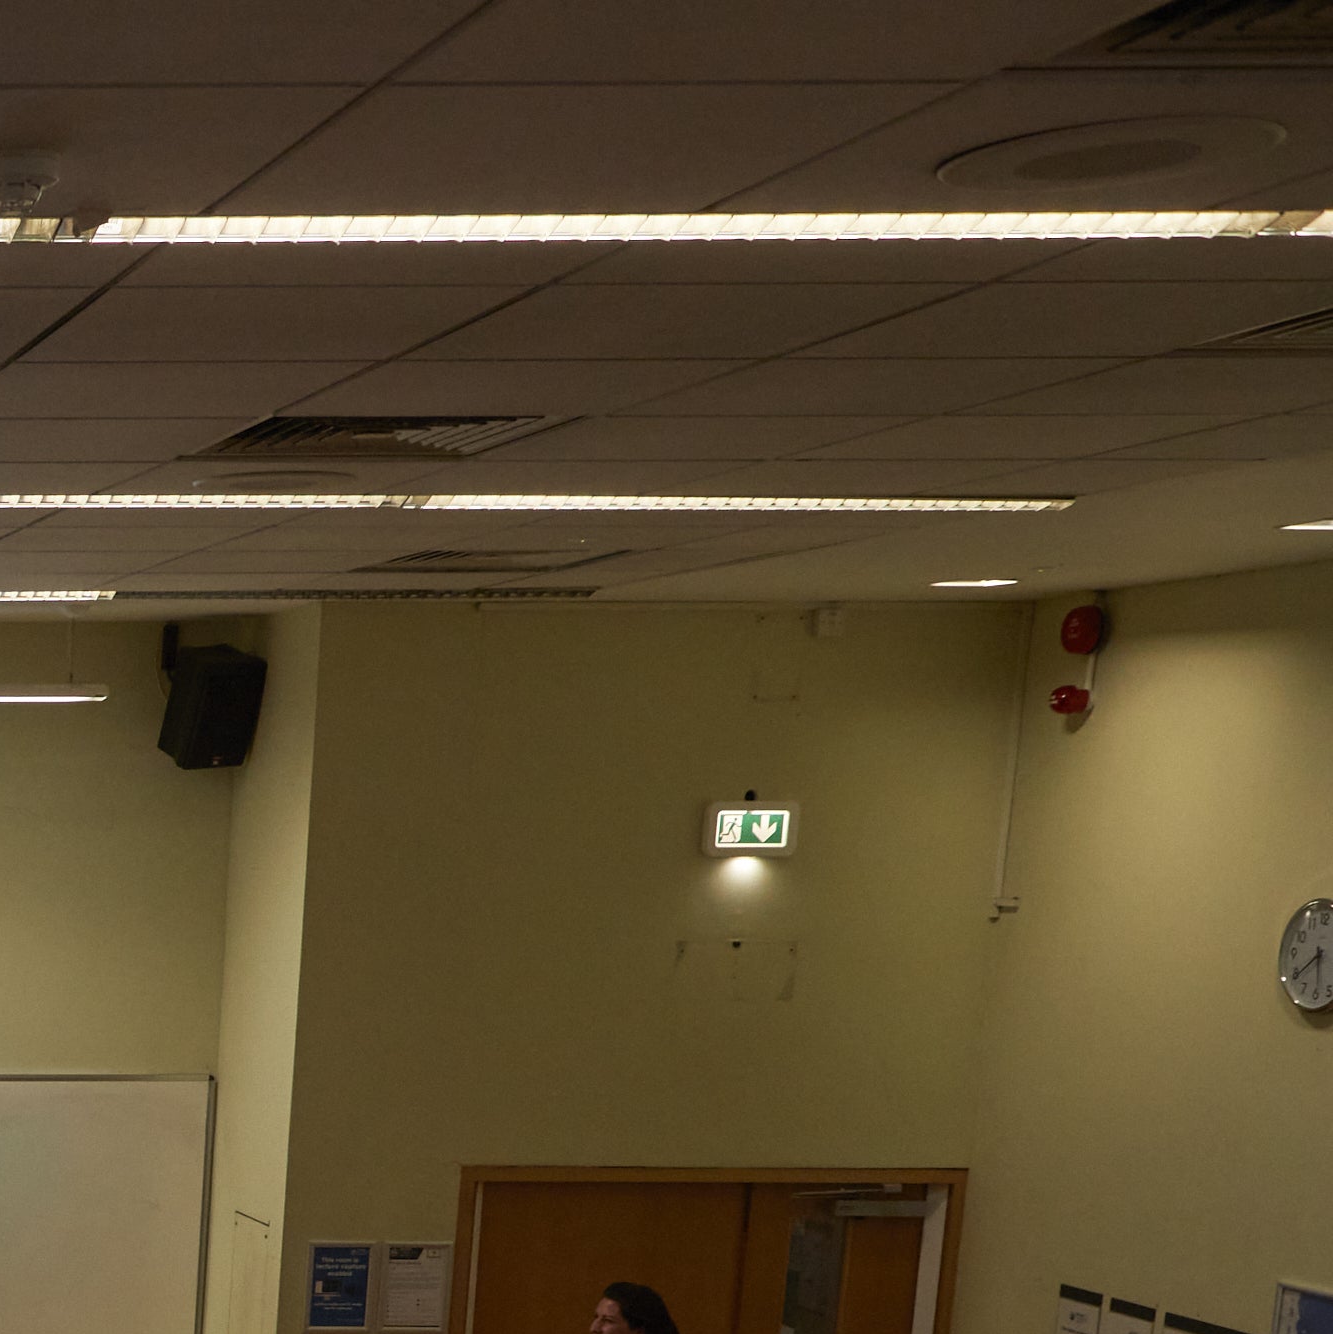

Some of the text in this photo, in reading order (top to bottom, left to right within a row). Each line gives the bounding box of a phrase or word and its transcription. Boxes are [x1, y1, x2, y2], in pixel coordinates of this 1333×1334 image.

[1308, 917, 1316, 930] 11
[1320, 912, 1330, 926] 12
[1291, 947, 1297, 959] 9
[1301, 982, 1307, 994] 7
[1312, 988, 1319, 1000] 6
